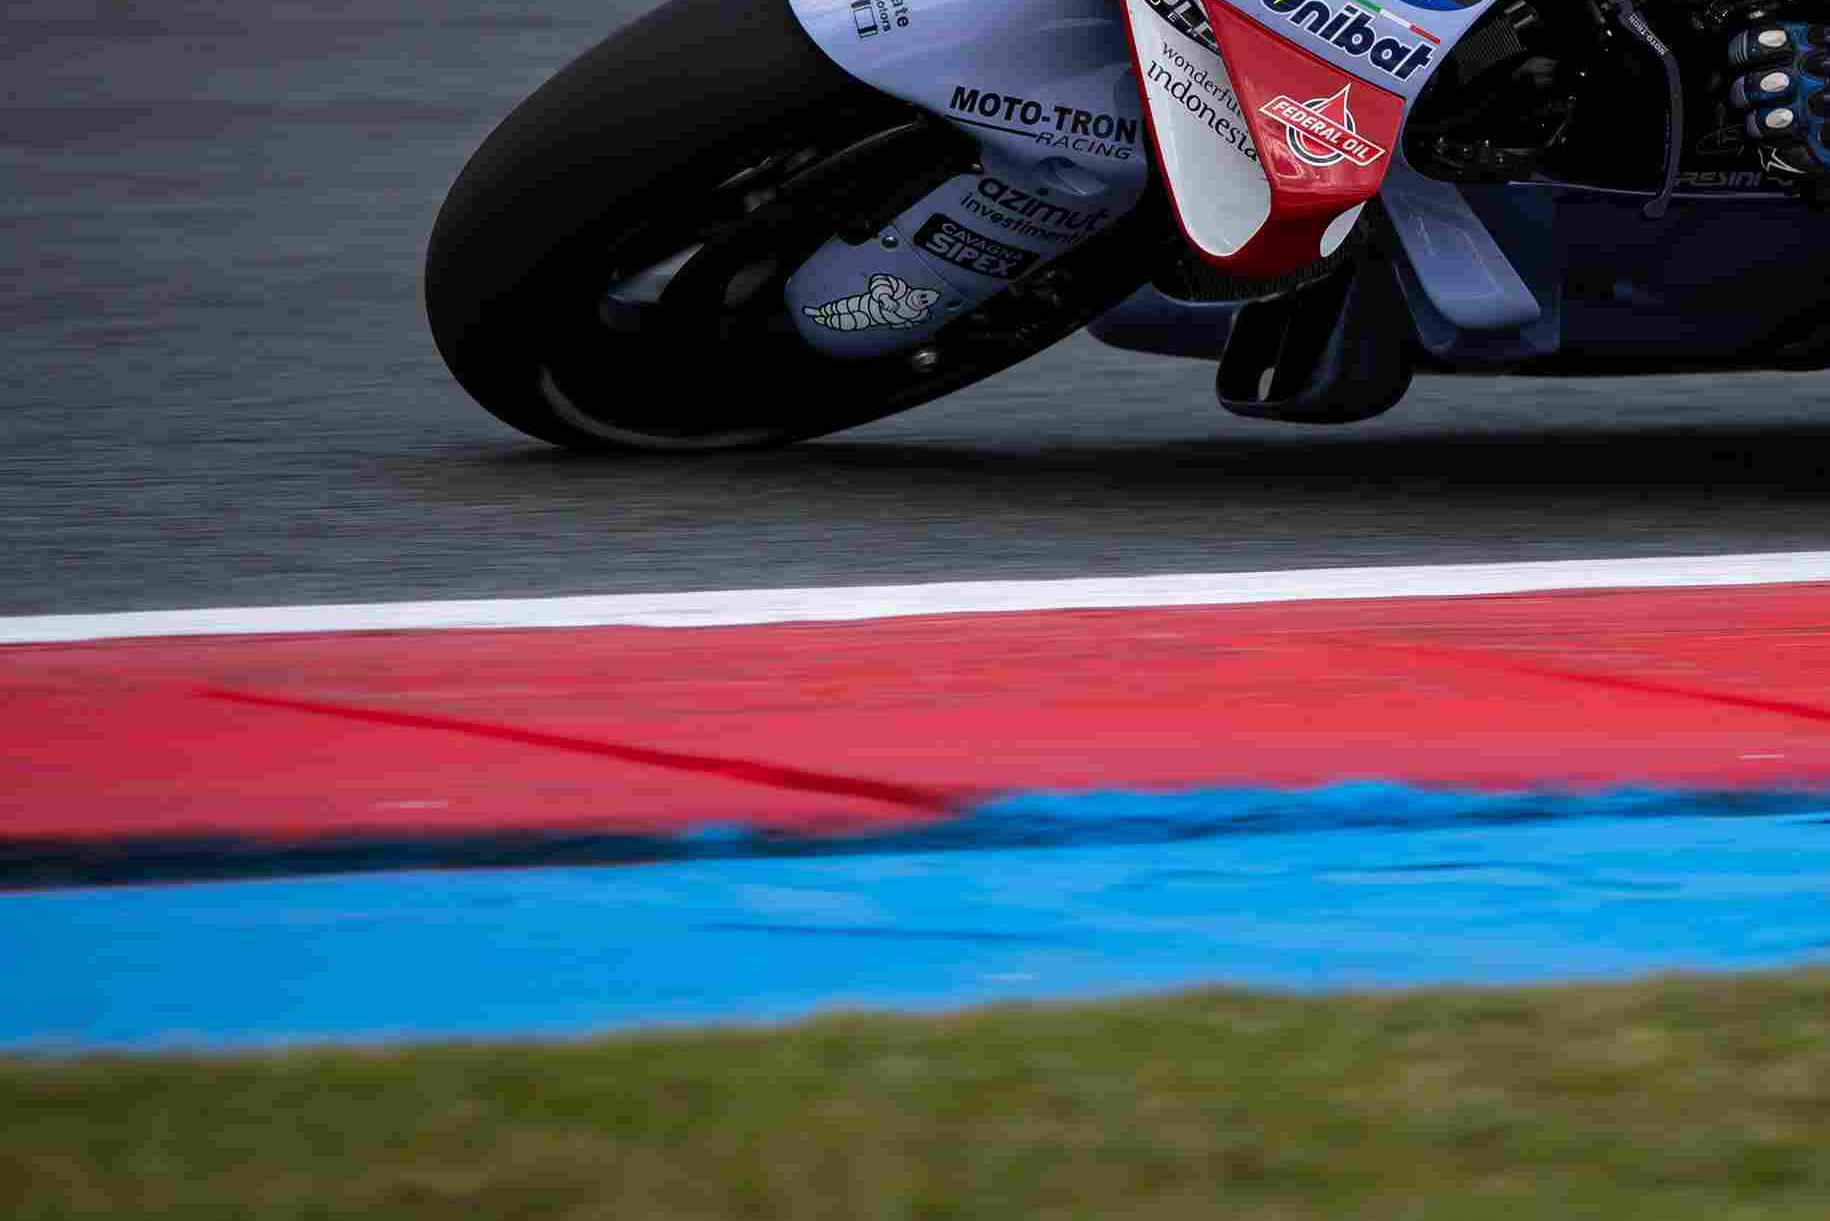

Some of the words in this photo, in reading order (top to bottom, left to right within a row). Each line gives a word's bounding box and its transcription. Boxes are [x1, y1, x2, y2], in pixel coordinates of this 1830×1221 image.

[949, 85, 1138, 145] MOTO-TRON
[1272, 99, 1345, 145] FEDERAL
[1340, 136, 1371, 160] OIL
[1035, 131, 1134, 161] RACING
[1671, 170, 1764, 189] RESINI
